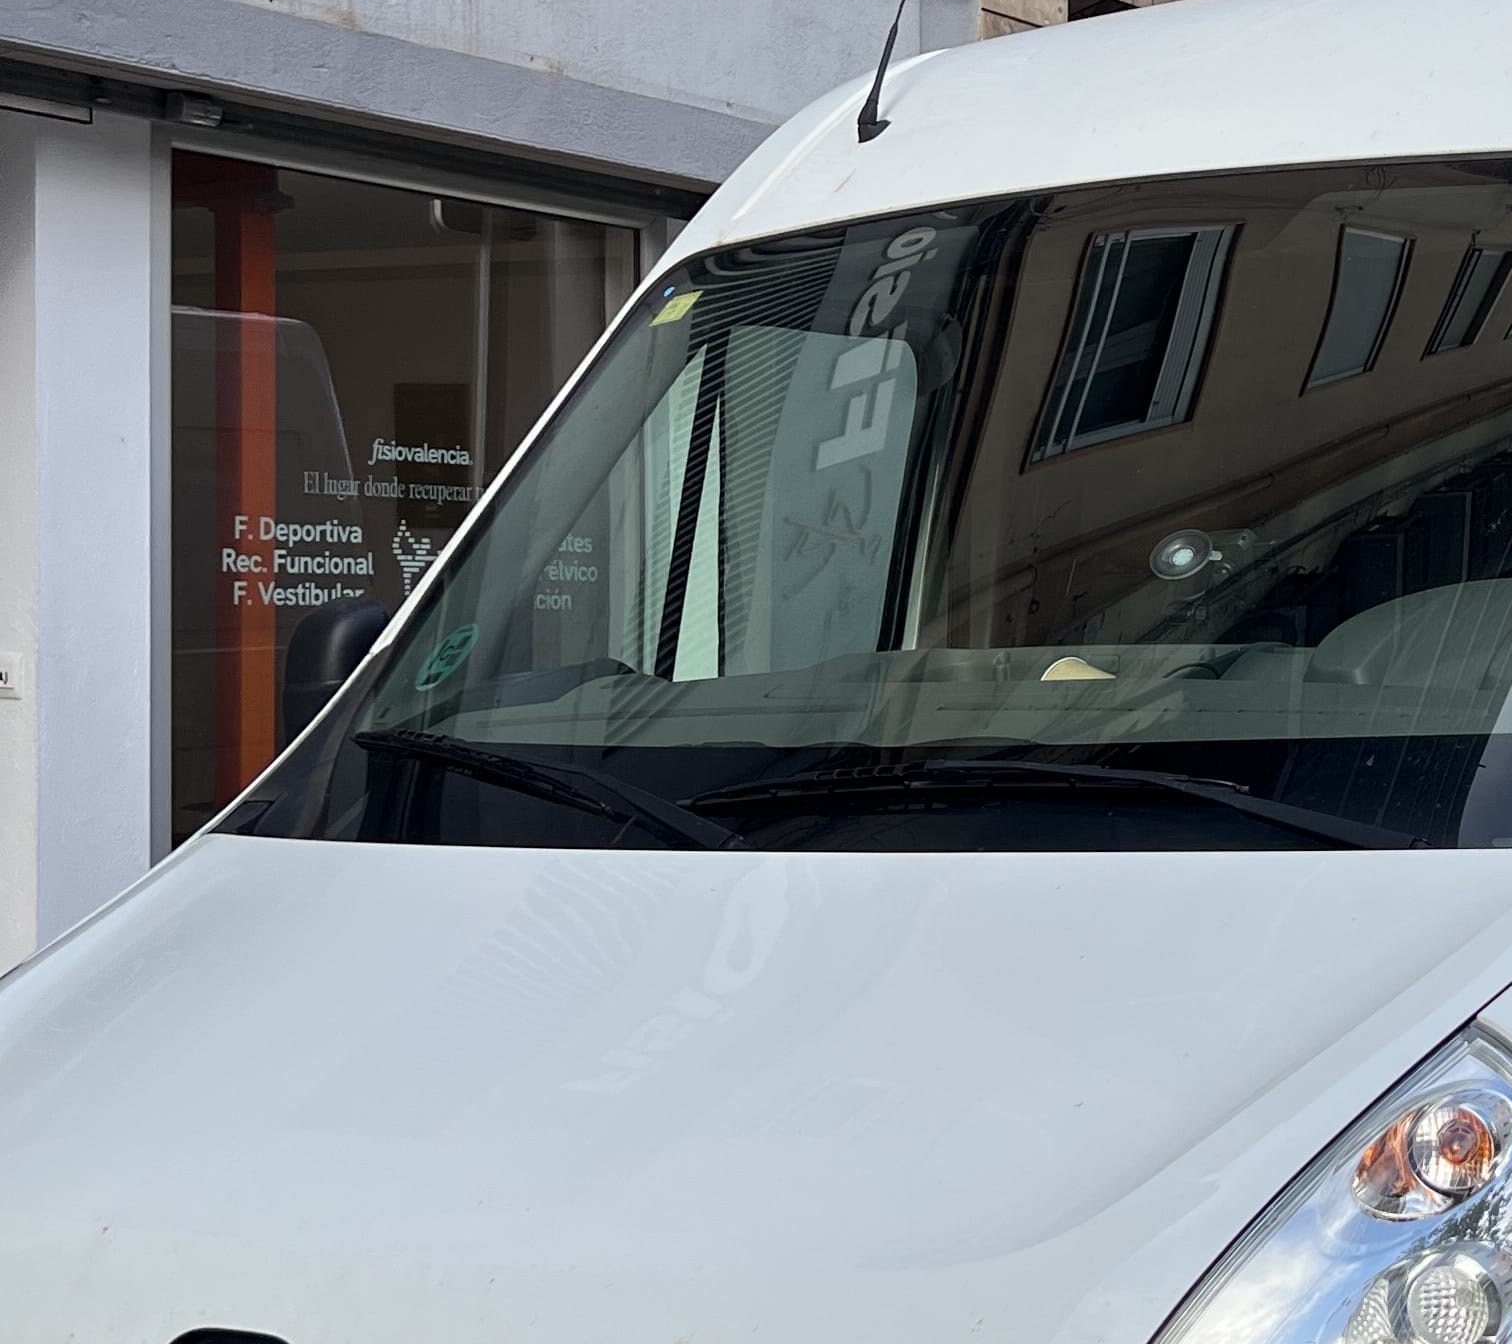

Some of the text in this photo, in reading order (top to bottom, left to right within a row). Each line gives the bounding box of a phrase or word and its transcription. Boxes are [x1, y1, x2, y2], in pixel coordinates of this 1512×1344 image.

[303, 471, 319, 494] El
[324, 472, 361, 501] lugar
[364, 474, 406, 498] donde
[409, 483, 473, 506] recuperar
[234, 515, 363, 548] F. Deportiva
[222, 548, 374, 575] Rec. Funcional
[233, 581, 252, 605] F.
